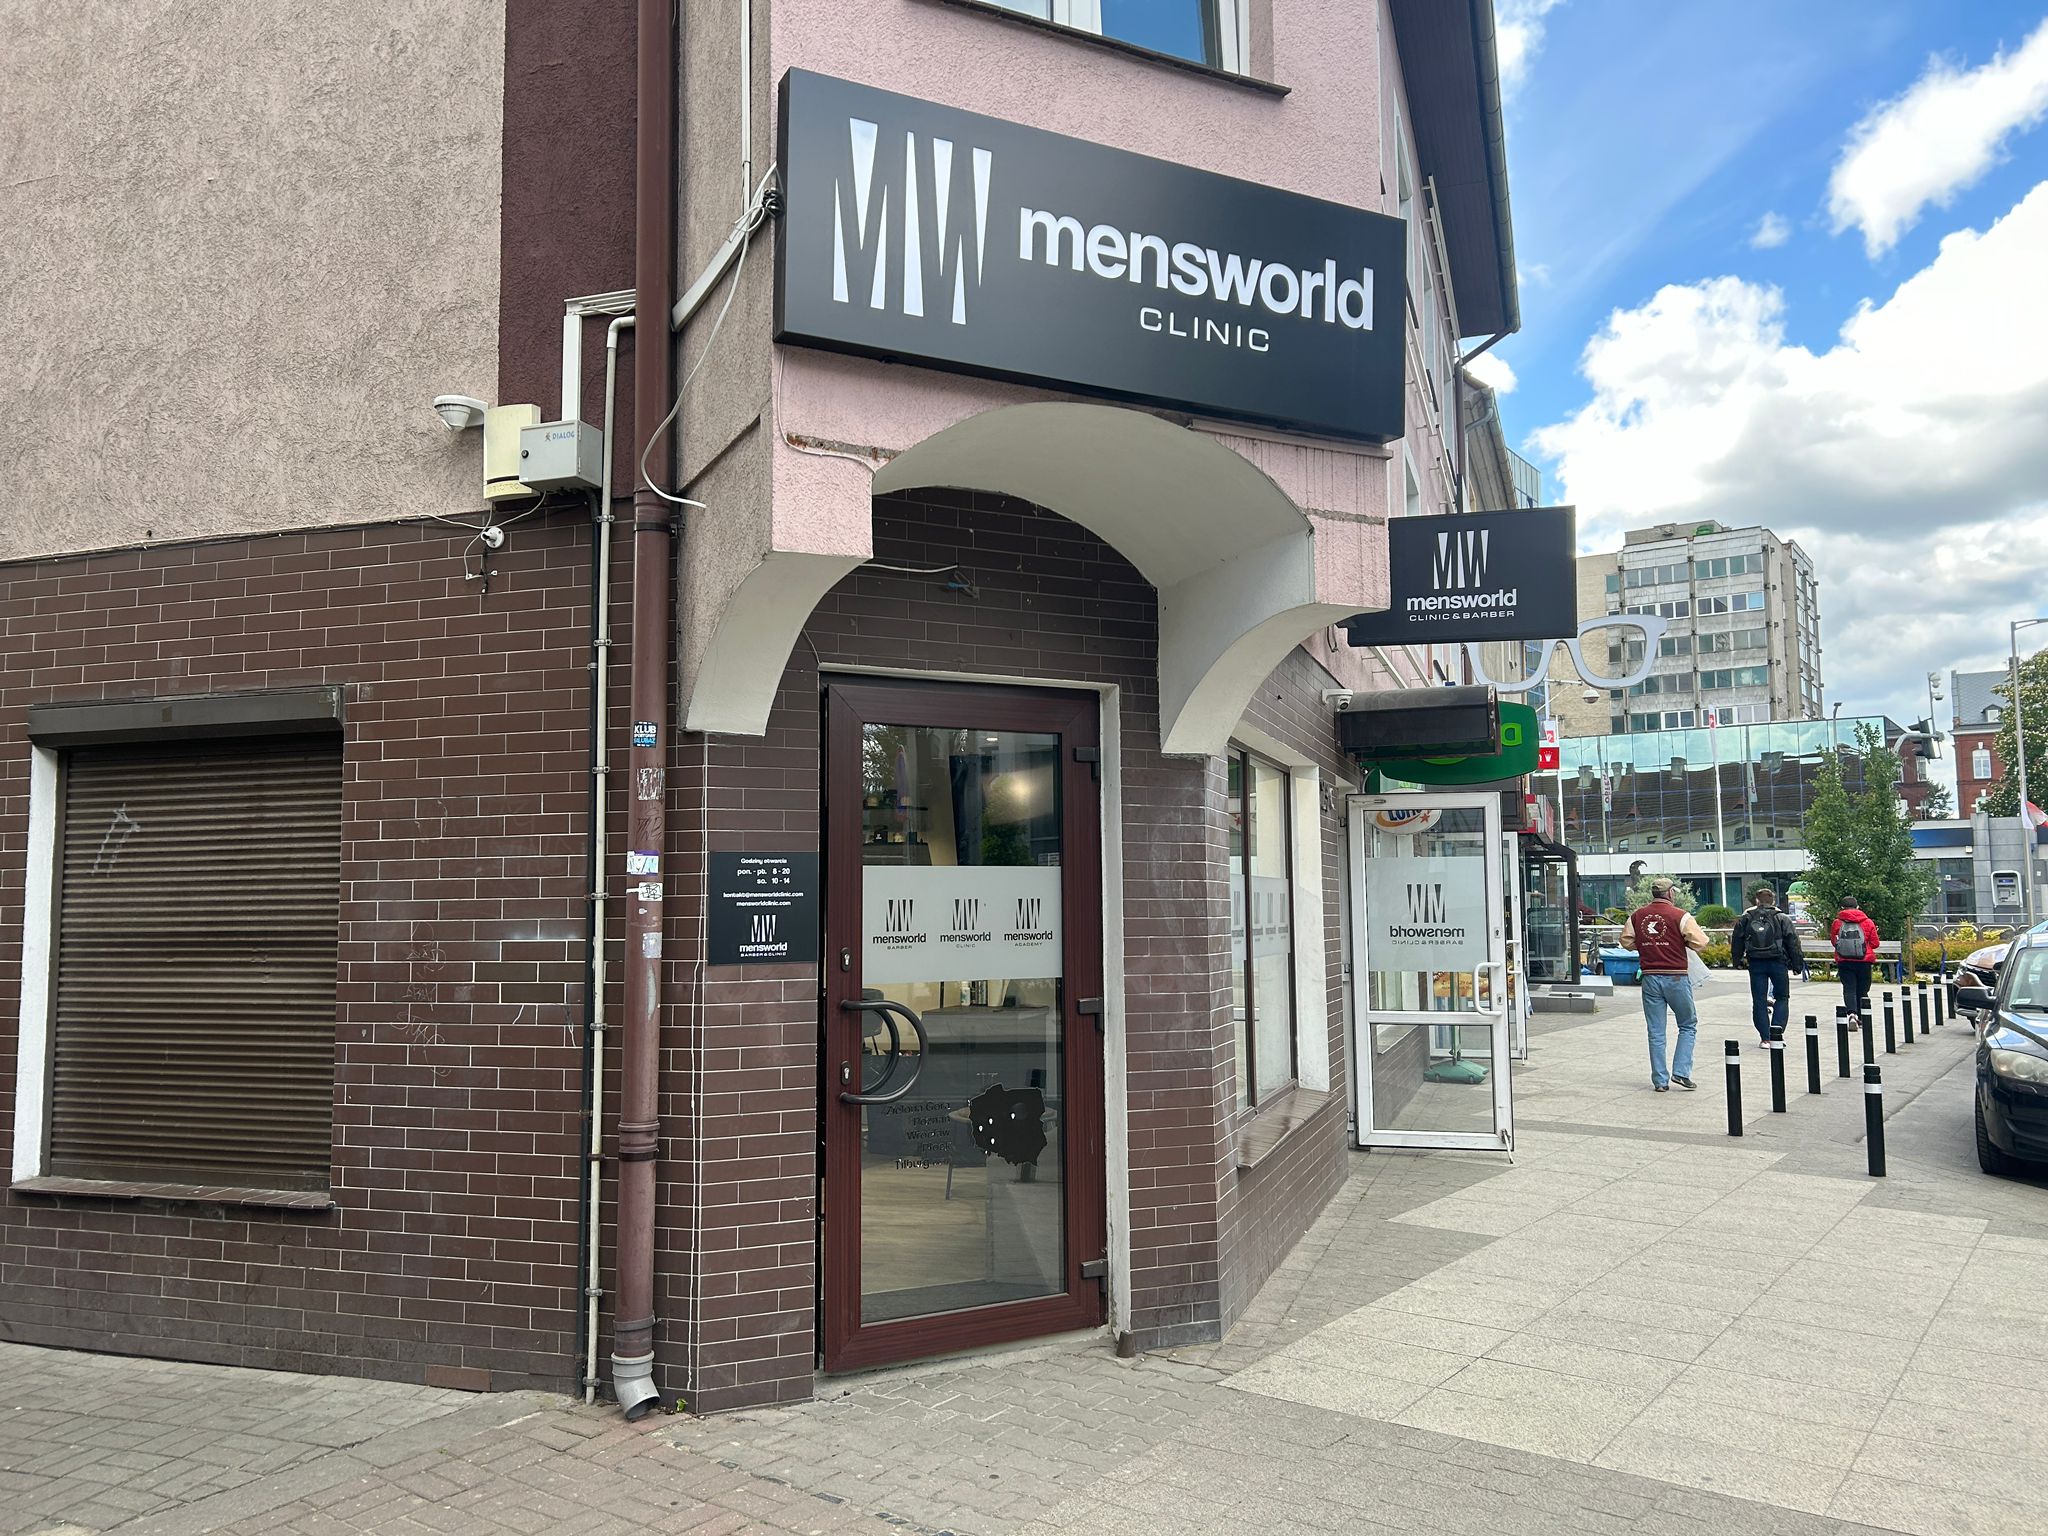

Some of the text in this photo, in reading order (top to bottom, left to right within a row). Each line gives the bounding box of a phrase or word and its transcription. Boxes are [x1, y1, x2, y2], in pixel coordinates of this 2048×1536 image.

[1019, 205, 1374, 331] mensworld
[1139, 306, 1270, 353] CLINIC
[552, 430, 575, 440] DIALOG
[1406, 588, 1518, 611] mensworld
[633, 725, 657, 734] KLUB
[737, 868, 752, 876] pon.
[873, 933, 926, 944] mensworld
[940, 932, 991, 942] mensworld
[1004, 931, 1053, 941] mensworld
[740, 942, 788, 952] mensworld
